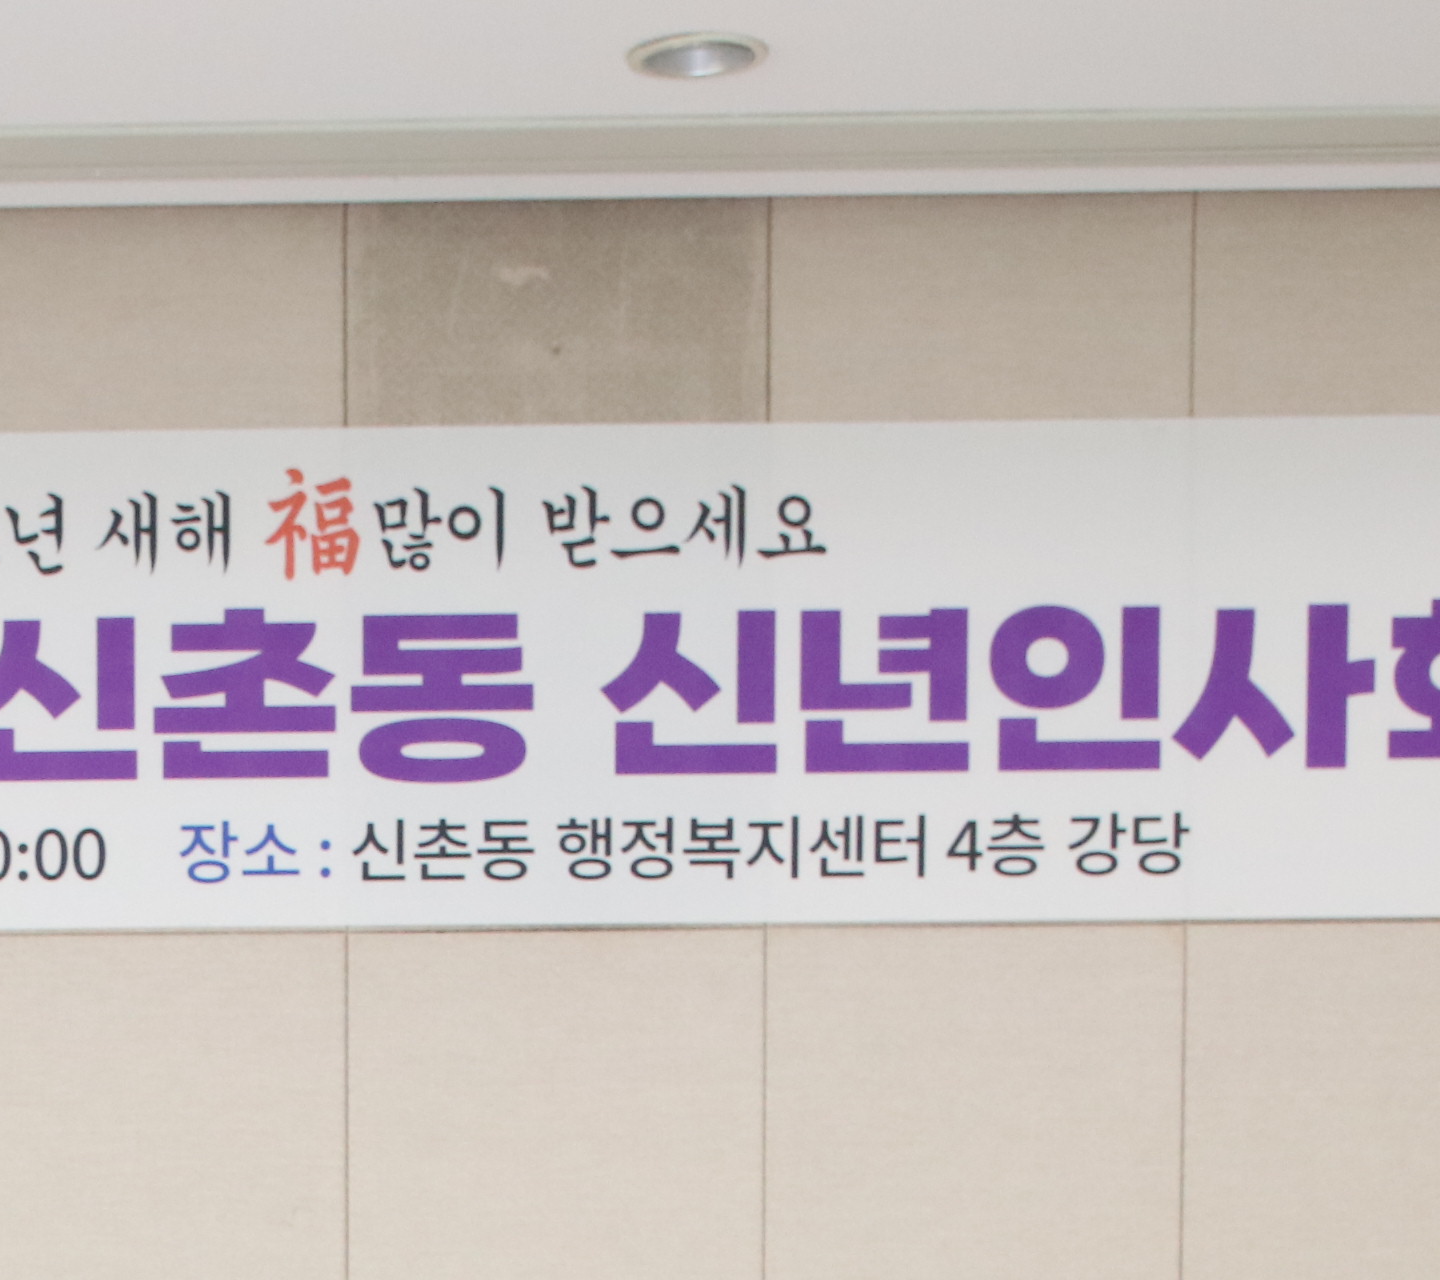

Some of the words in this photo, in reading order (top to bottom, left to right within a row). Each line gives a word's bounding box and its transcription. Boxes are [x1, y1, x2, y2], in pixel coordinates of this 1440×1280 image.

[97, 489, 233, 576] 새해
[543, 485, 826, 568] 받으세요
[353, 819, 534, 881] 신촌동
[557, 815, 925, 880] 행정복지센터
[947, 814, 1044, 876] 4층
[1069, 812, 1189, 875] 강당
